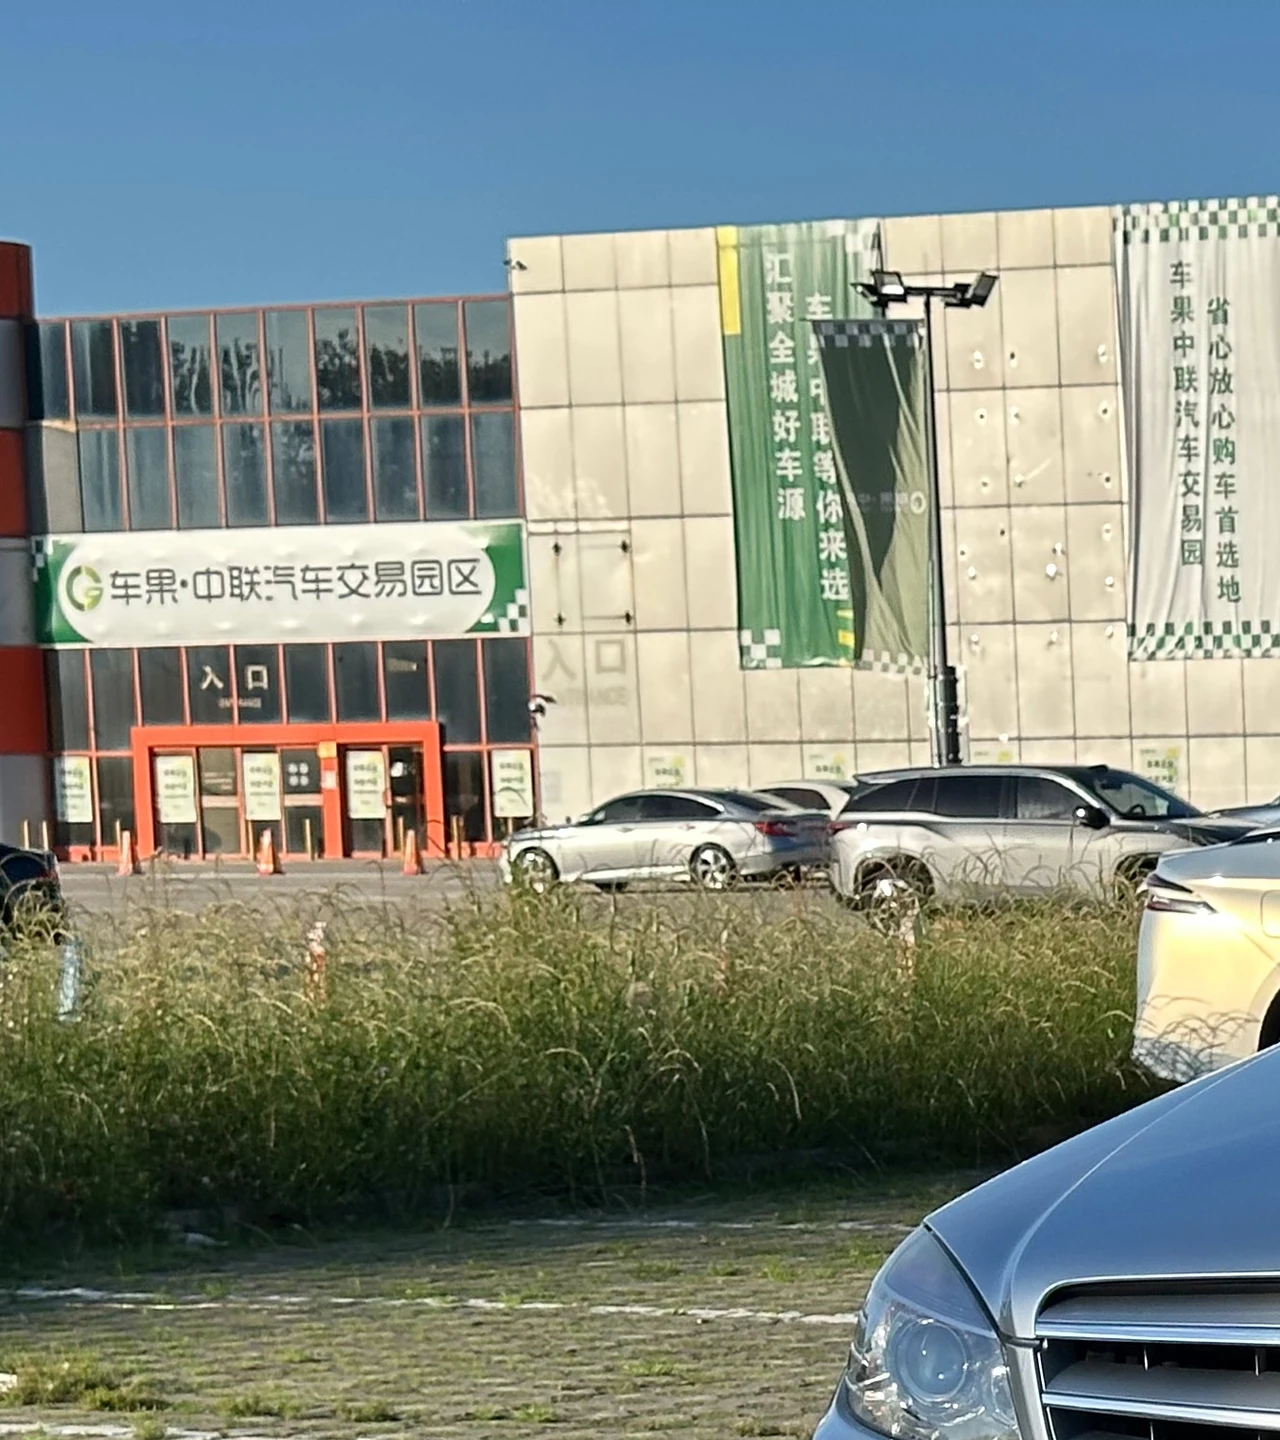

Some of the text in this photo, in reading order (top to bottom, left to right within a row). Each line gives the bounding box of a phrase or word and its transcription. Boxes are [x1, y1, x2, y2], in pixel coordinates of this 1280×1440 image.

[764, 252, 807, 522] 汇聚全城好车源
[1169, 259, 1204, 568] 车果中联汽车交易园
[1207, 296, 1242, 604] 省心放心购车首选地
[109, 557, 483, 606] 车果·中联汽车交易园区
[541, 638, 626, 682] 入口
[200, 664, 269, 691] 入口
